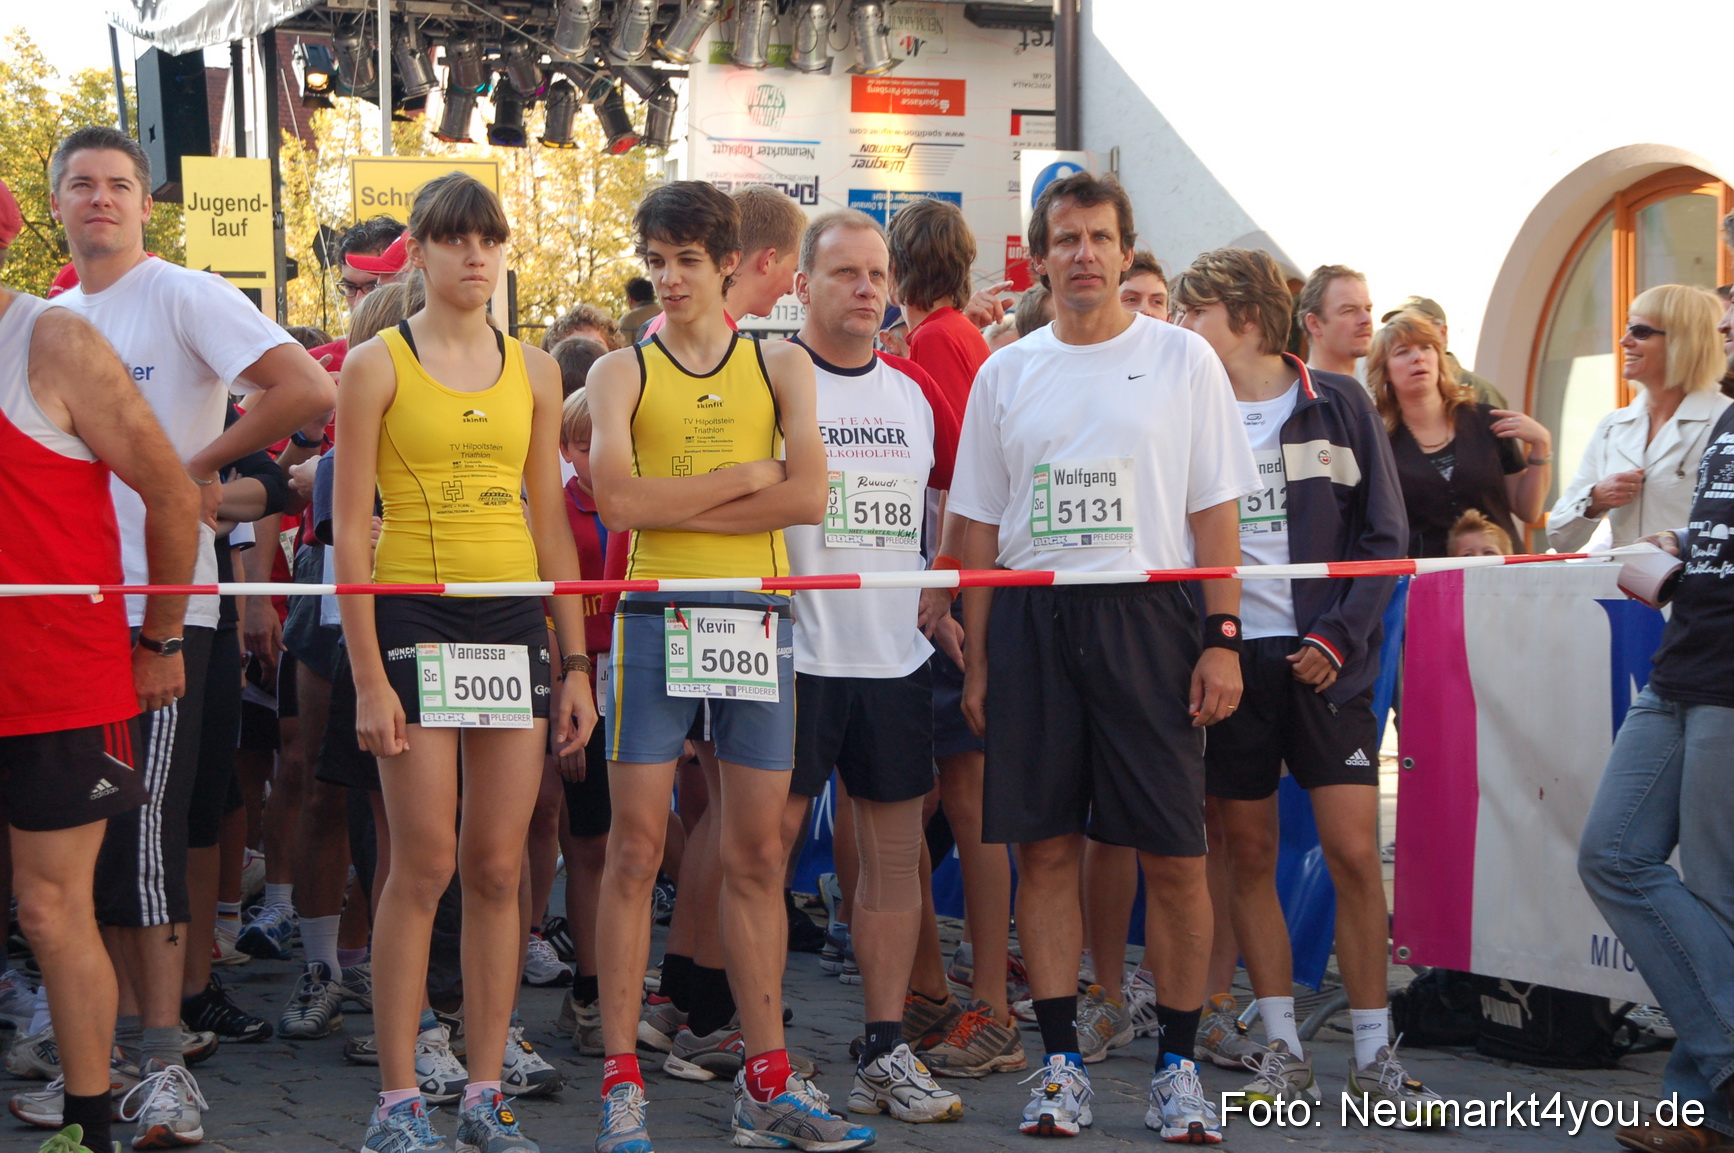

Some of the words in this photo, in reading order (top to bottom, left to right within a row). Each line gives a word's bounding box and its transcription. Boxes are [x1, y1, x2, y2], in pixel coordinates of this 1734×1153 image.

[744, 85, 785, 107] SCHAU
[867, 85, 940, 97] Neumarkt-Parsberg
[900, 97, 939, 107] Sparkasse
[748, 105, 784, 132] RUND
[712, 144, 753, 159] Tagblatt
[757, 146, 815, 160] Neumarkter
[188, 192, 268, 217] Jugend-
[211, 217, 249, 237] lauf
[696, 401, 723, 409] skinfit
[695, 417, 735, 425] Hilpoltstein
[838, 417, 883, 426] TEAM
[693, 426, 724, 434] Triathlon
[818, 426, 909, 448] ERDINGER
[462, 443, 503, 451] Hilpoltstein
[1054, 468, 1117, 487] Wolfgang
[1034, 498, 1044, 511] Sc
[1058, 498, 1122, 524] 5131
[854, 501, 912, 527] 5188
[886, 537, 918, 545] PFLEIDERER
[1093, 533, 1133, 541] PFLEIDERER
[697, 617, 736, 634] Kevin
[448, 643, 506, 661] Vanessa
[671, 643, 684, 656] Sc
[701, 648, 769, 676] 5080
[423, 669, 438, 682] Sc
[454, 675, 522, 701] 5000
[668, 683, 712, 693] BOCK
[737, 685, 777, 696] PFLEIDERER
[422, 712, 466, 722] BOCK
[491, 713, 531, 722] PFLEIDERER
[1345, 759, 1370, 767] adidas
[90, 787, 120, 801] adidas
